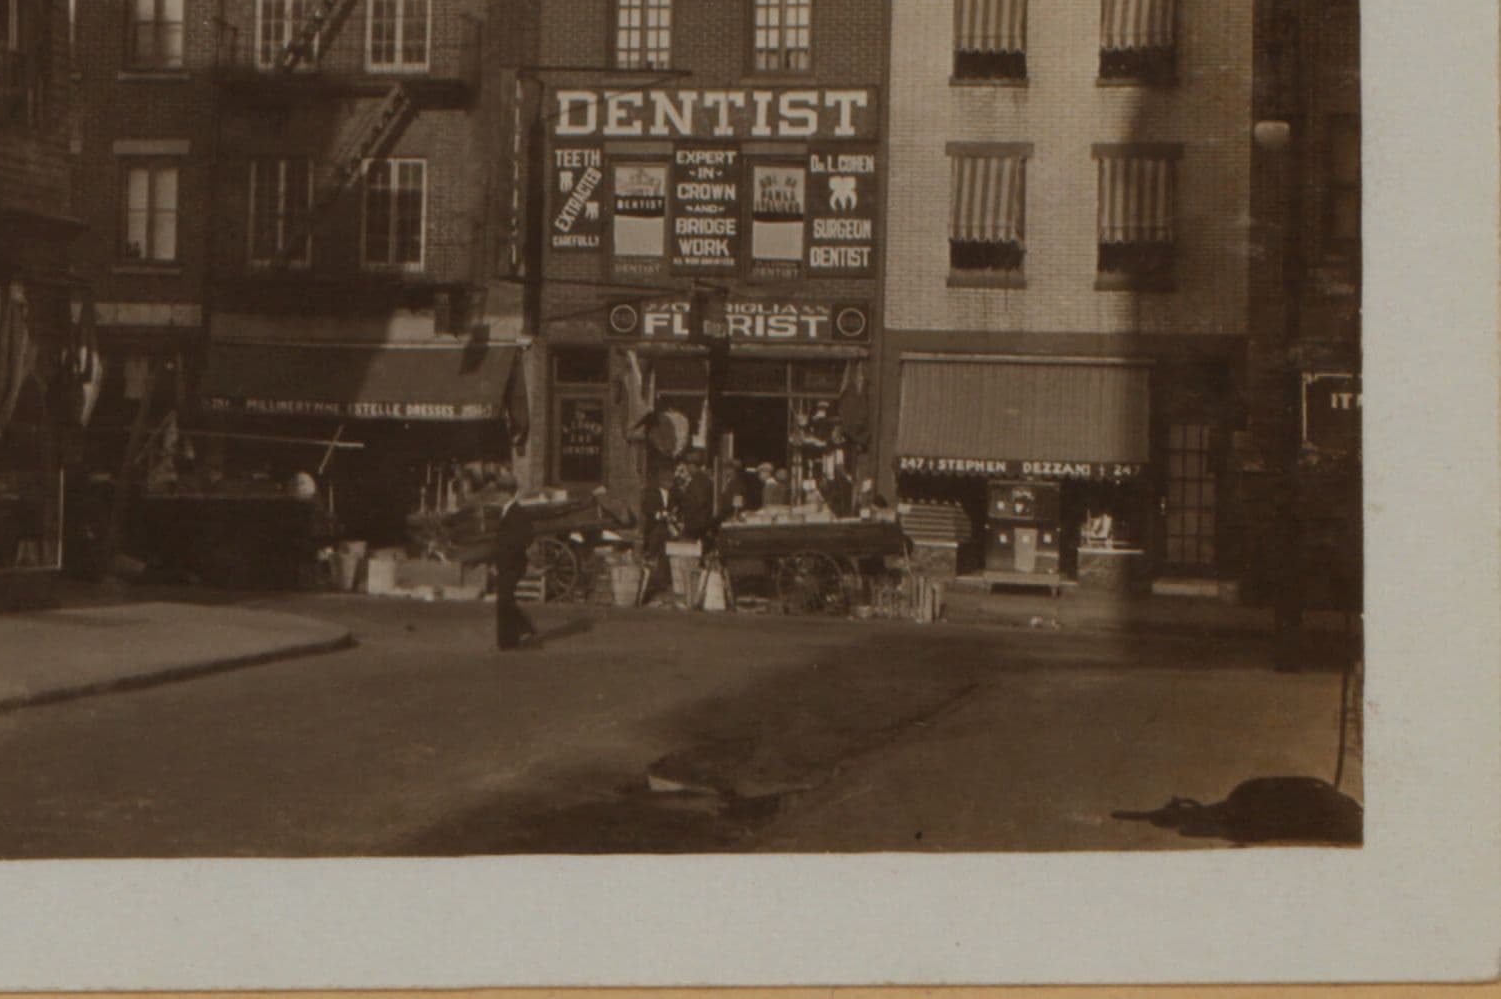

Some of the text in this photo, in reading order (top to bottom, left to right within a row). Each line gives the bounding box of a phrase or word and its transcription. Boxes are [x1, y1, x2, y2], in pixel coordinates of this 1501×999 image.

[555, 89, 867, 137] DENTIST
[555, 149, 601, 167] TEETH
[675, 150, 737, 165] EXPERT
[698, 167, 714, 180] IN
[554, 167, 602, 232] EXTRACTED
[677, 183, 737, 201] CROWN
[617, 199, 663, 210] DENTIST
[675, 218, 737, 235] BRIDGE
[813, 219, 872, 239] SURGEON
[678, 239, 730, 256] WORK
[810, 247, 871, 267] DENTIST
[644, 313, 829, 338] FLRIST
[900, 457, 1141, 477] 247 STEPHEN DEZZANI 247
